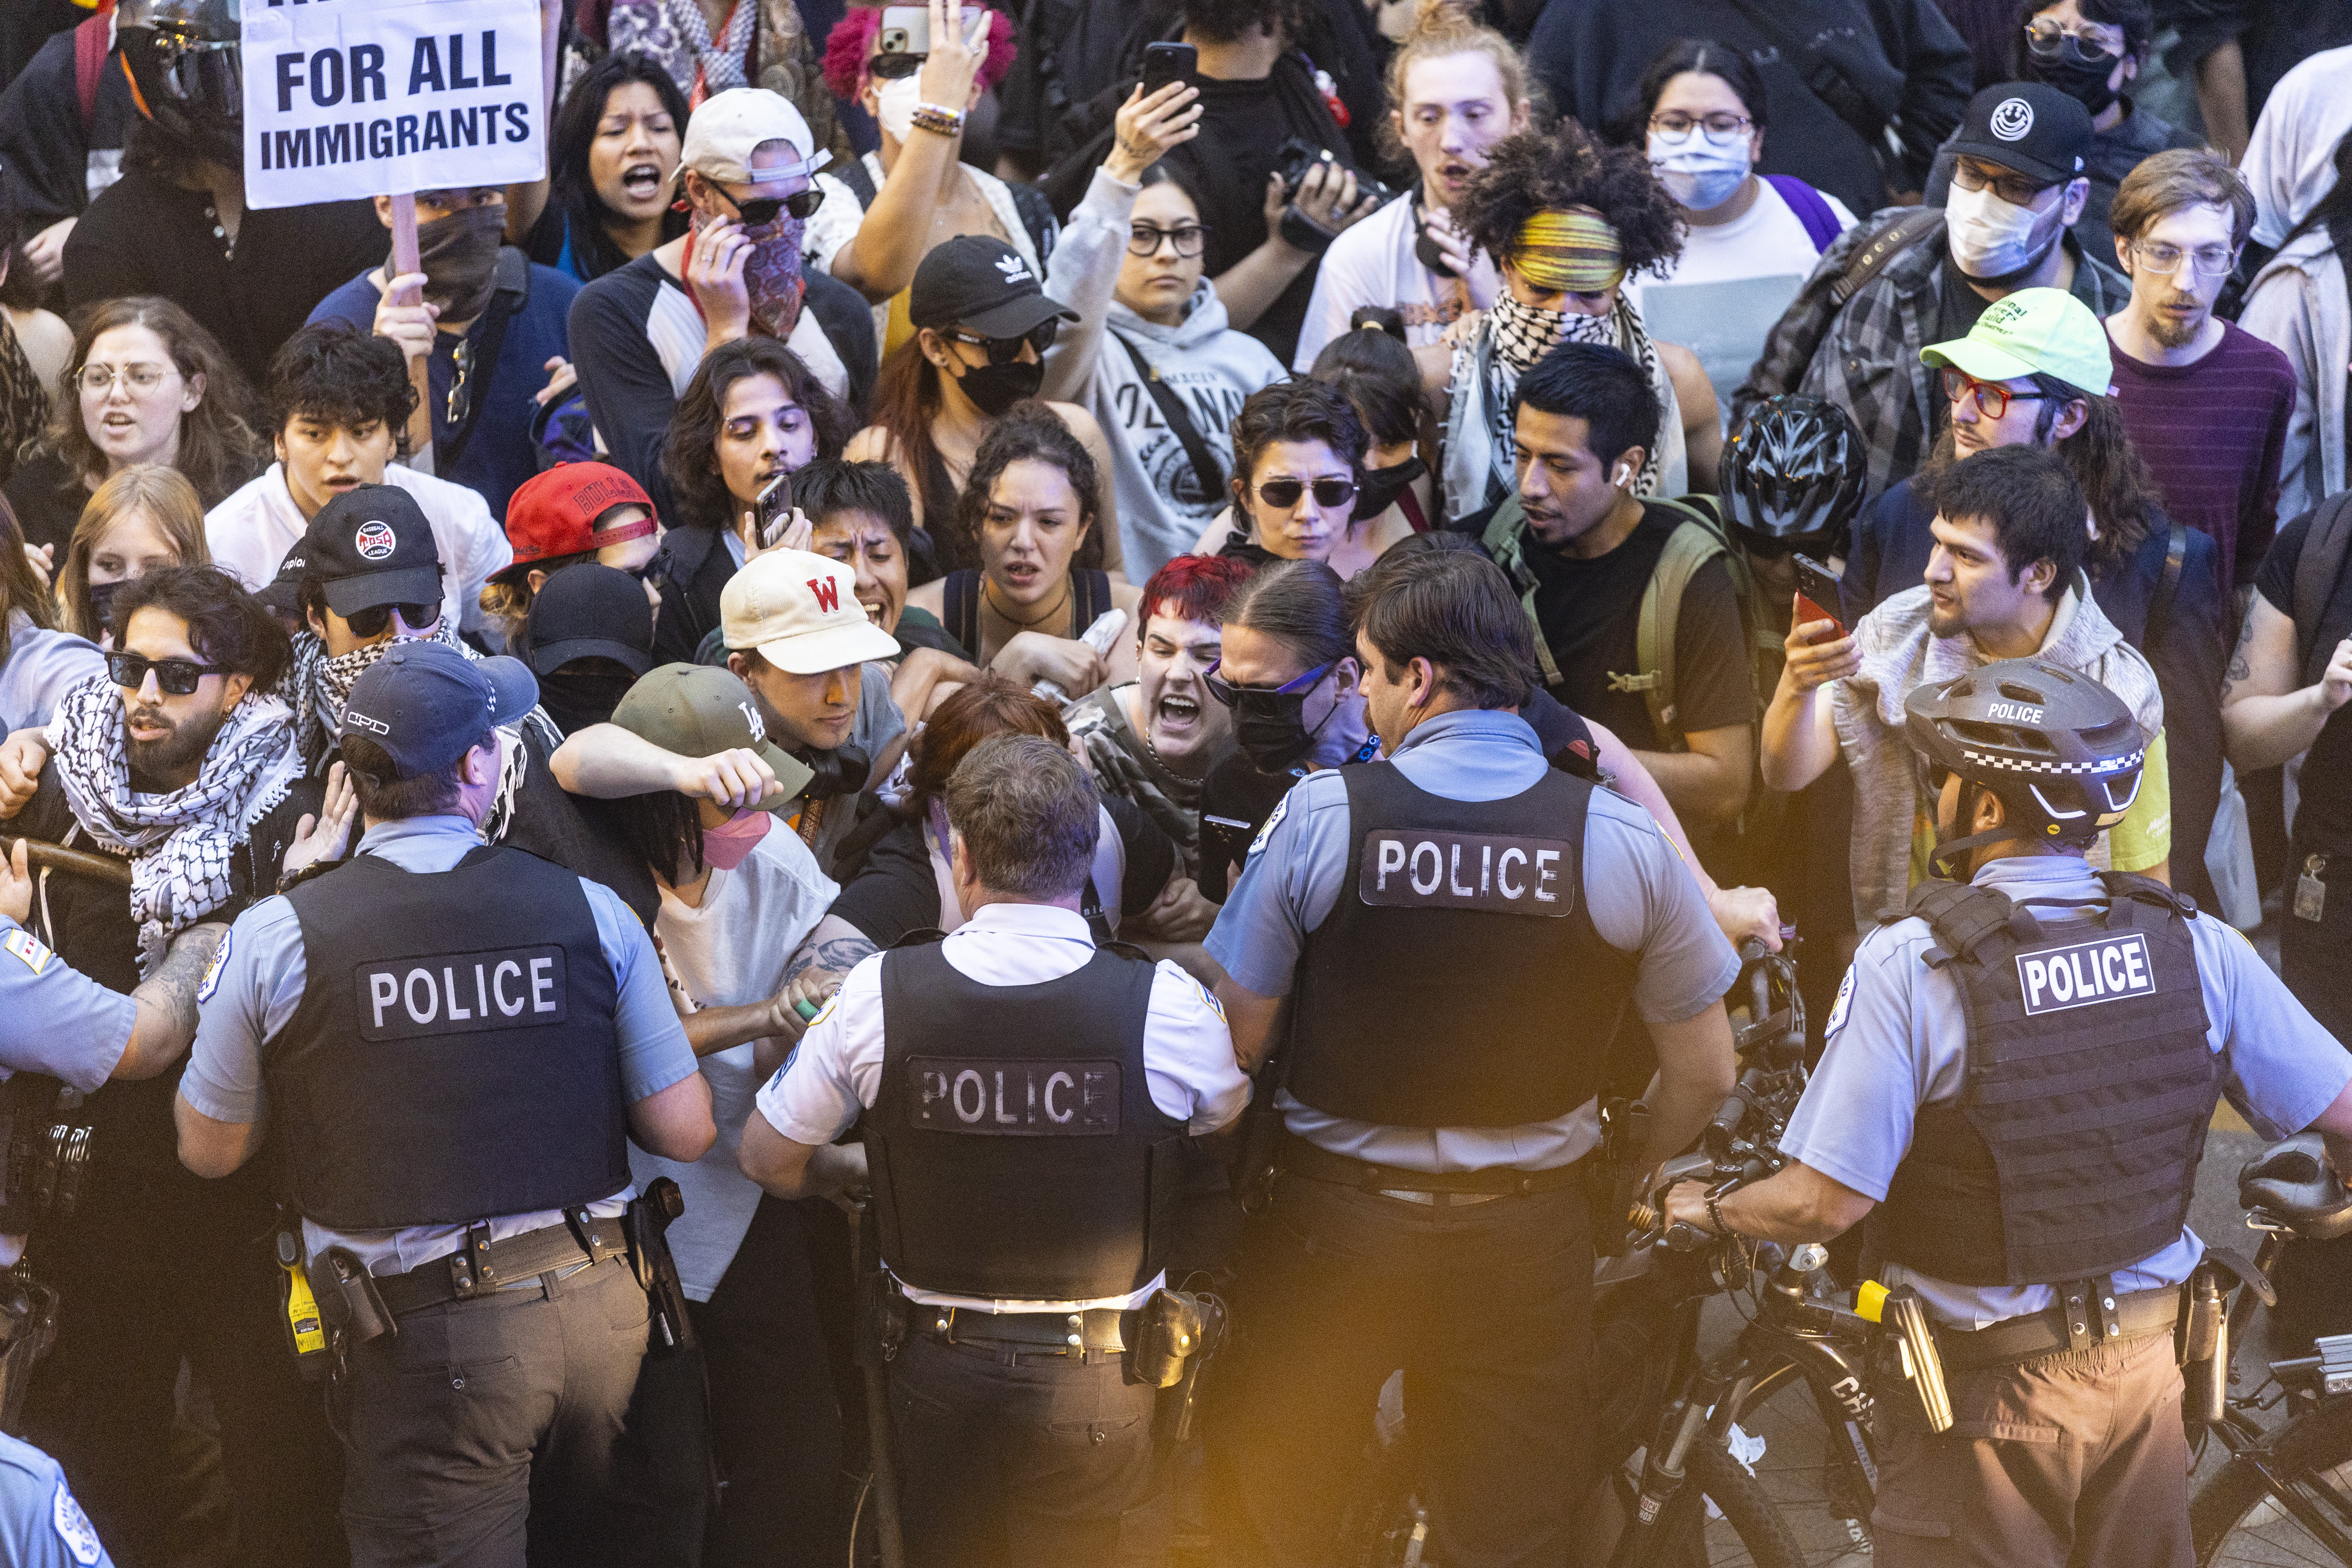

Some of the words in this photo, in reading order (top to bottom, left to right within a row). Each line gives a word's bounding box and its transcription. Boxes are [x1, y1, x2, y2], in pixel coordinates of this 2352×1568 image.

[276, 44, 387, 113] FOR
[408, 30, 512, 96] ALL
[261, 101, 531, 171] IMMIGRANTS
[359, 530, 392, 552] TOSA
[806, 576, 839, 613] W
[347, 711, 390, 735] CPD
[738, 701, 766, 742] LA
[1987, 703, 2044, 724] POLICE
[1377, 840, 1560, 902] POLICE
[369, 957, 556, 1028] POLICE
[2025, 942, 2148, 1006] POLICE
